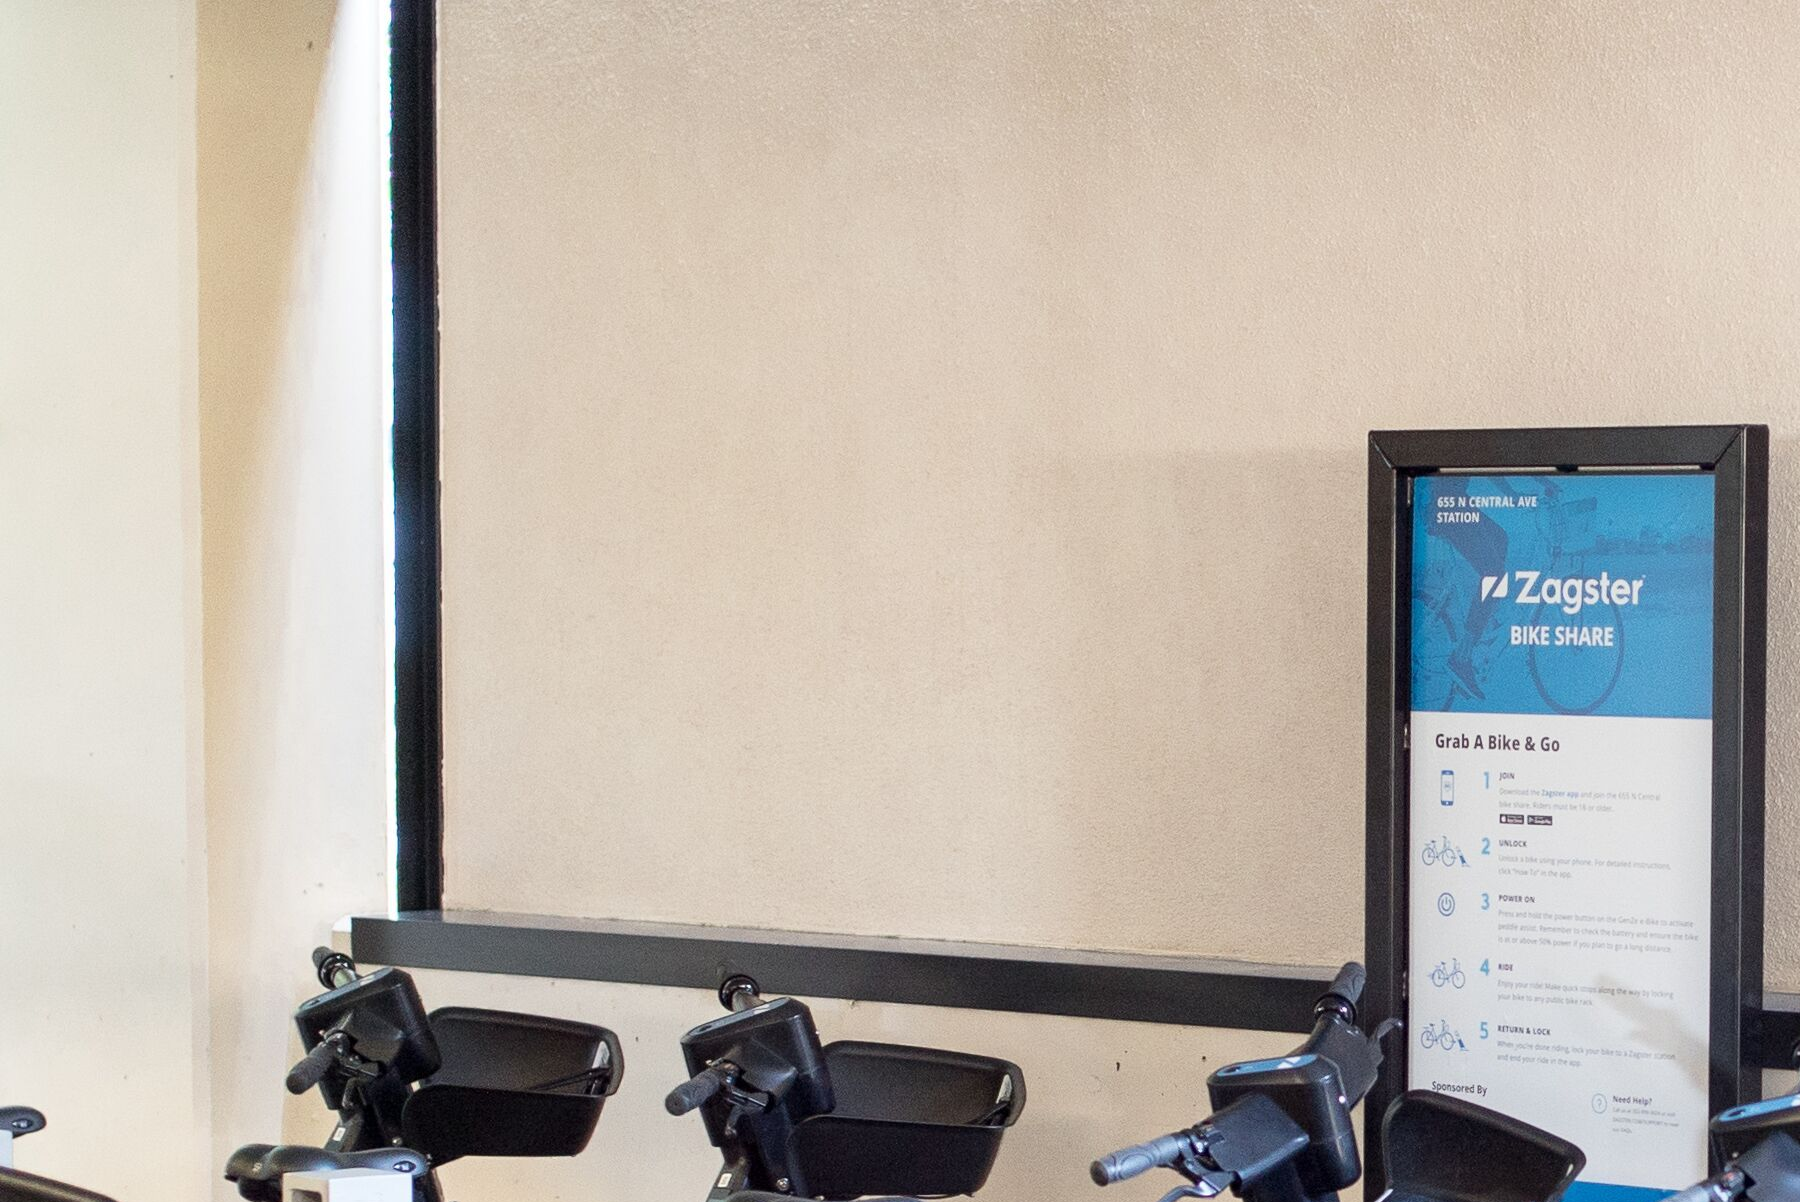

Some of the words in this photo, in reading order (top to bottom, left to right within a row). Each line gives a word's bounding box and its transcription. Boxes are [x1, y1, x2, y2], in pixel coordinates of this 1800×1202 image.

[1437, 496, 1455, 508] 655
[1458, 496, 1466, 507] N
[1469, 496, 1515, 508] CENTRAL
[1517, 496, 1537, 508] AVE
[1437, 512, 1480, 523] STATION
[1514, 571, 1643, 615] Zagster
[1510, 626, 1550, 646] BIKE
[1555, 626, 1614, 647] SHARE
[1435, 733, 1470, 749] Grab
[1474, 735, 1484, 749] A
[1488, 734, 1520, 751] Bike
[1524, 736, 1536, 751] &
[1540, 736, 1560, 752] Go
[1483, 771, 1490, 789] 1
[1499, 772, 1515, 781] JOIN
[1481, 838, 1490, 855] 2
[1499, 839, 1528, 848] UNLOCK
[1481, 893, 1490, 910] 3
[1499, 894, 1522, 903] POWER
[1480, 958, 1490, 976] 4
[1480, 1022, 1489, 1039] 5
[1497, 1025, 1524, 1035] RETURN
[1533, 1027, 1551, 1036] LOCK
[1432, 1081, 1475, 1094] Sponsored
[1477, 1083, 1488, 1097] By
[1612, 1096, 1631, 1104] Need
[1632, 1096, 1653, 1106] Help?
